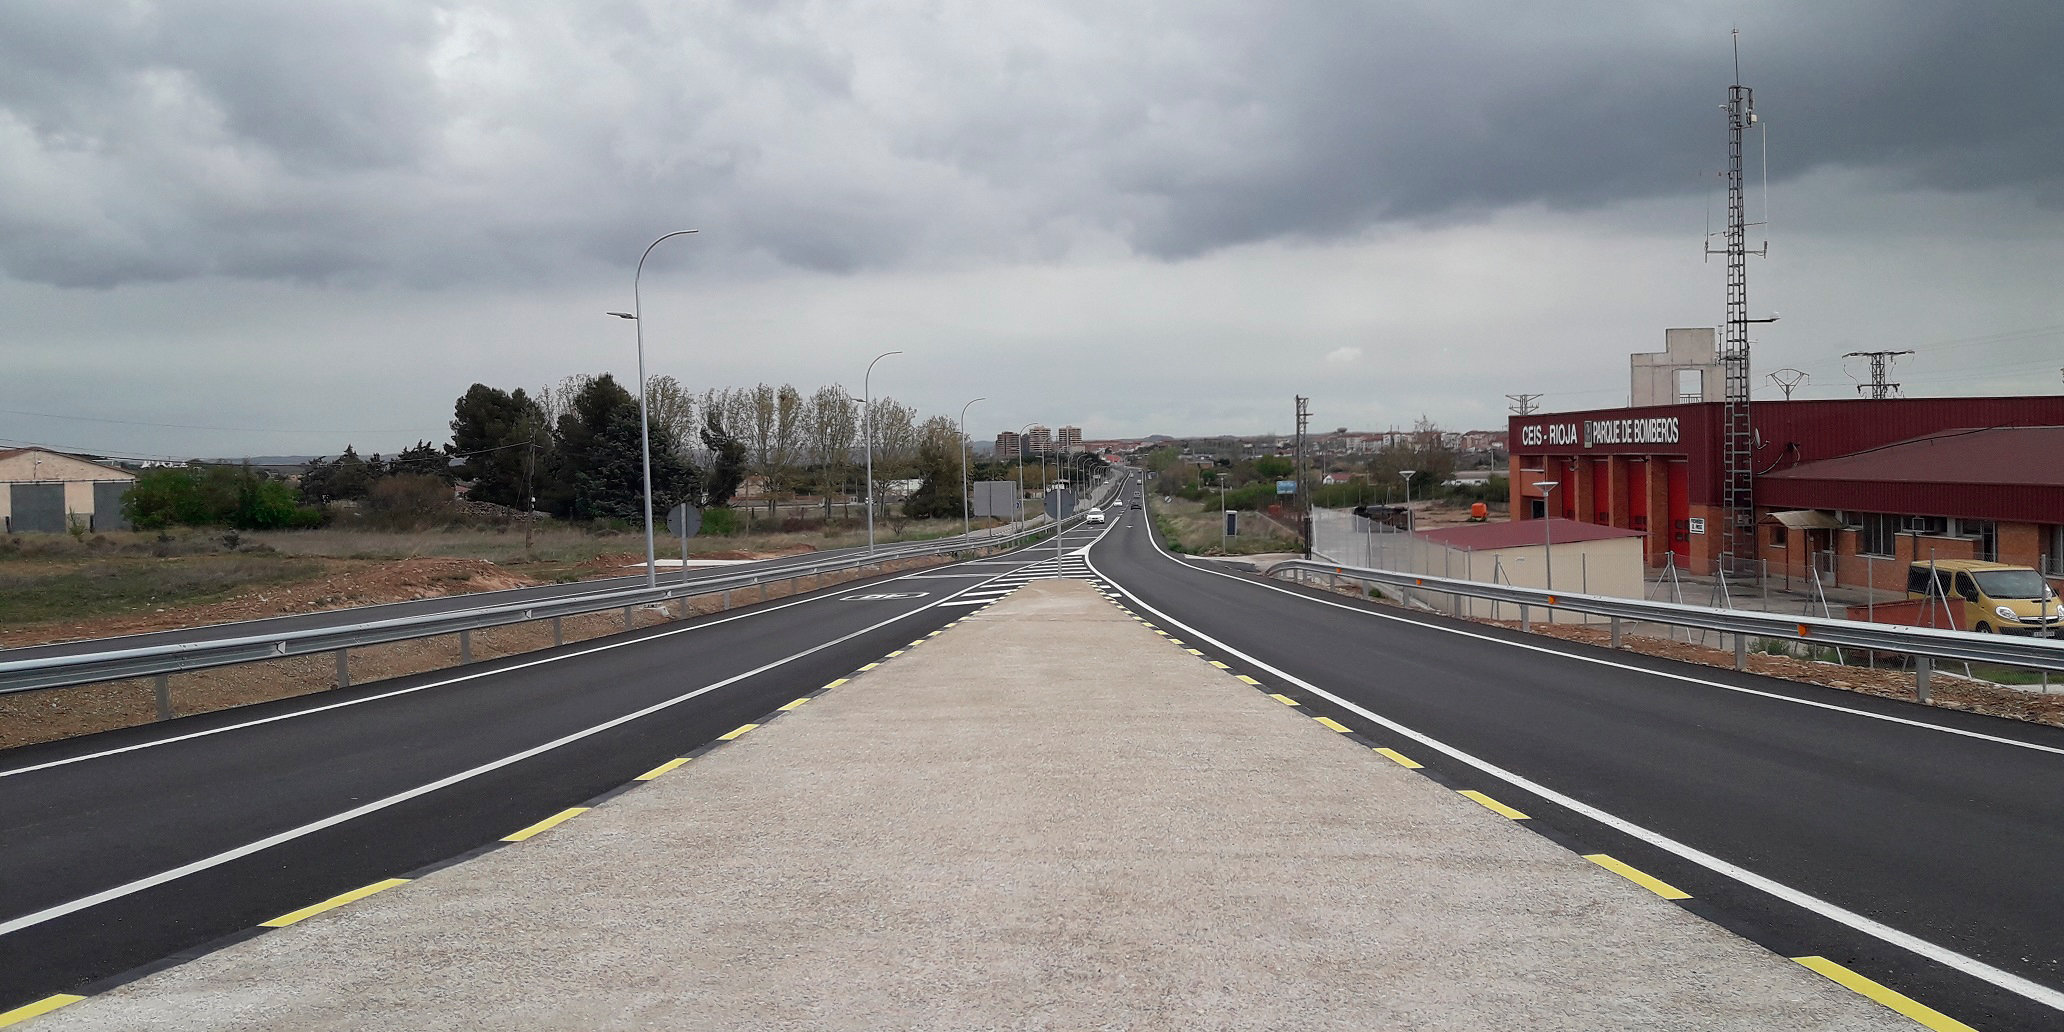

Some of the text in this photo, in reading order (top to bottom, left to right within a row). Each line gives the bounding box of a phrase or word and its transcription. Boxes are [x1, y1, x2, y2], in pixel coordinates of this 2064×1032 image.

[1522, 425, 1542, 446] CEIS
[1549, 424, 1578, 445] RIOJA
[1593, 417, 1679, 443] PARQUE DE BOMBEROS
